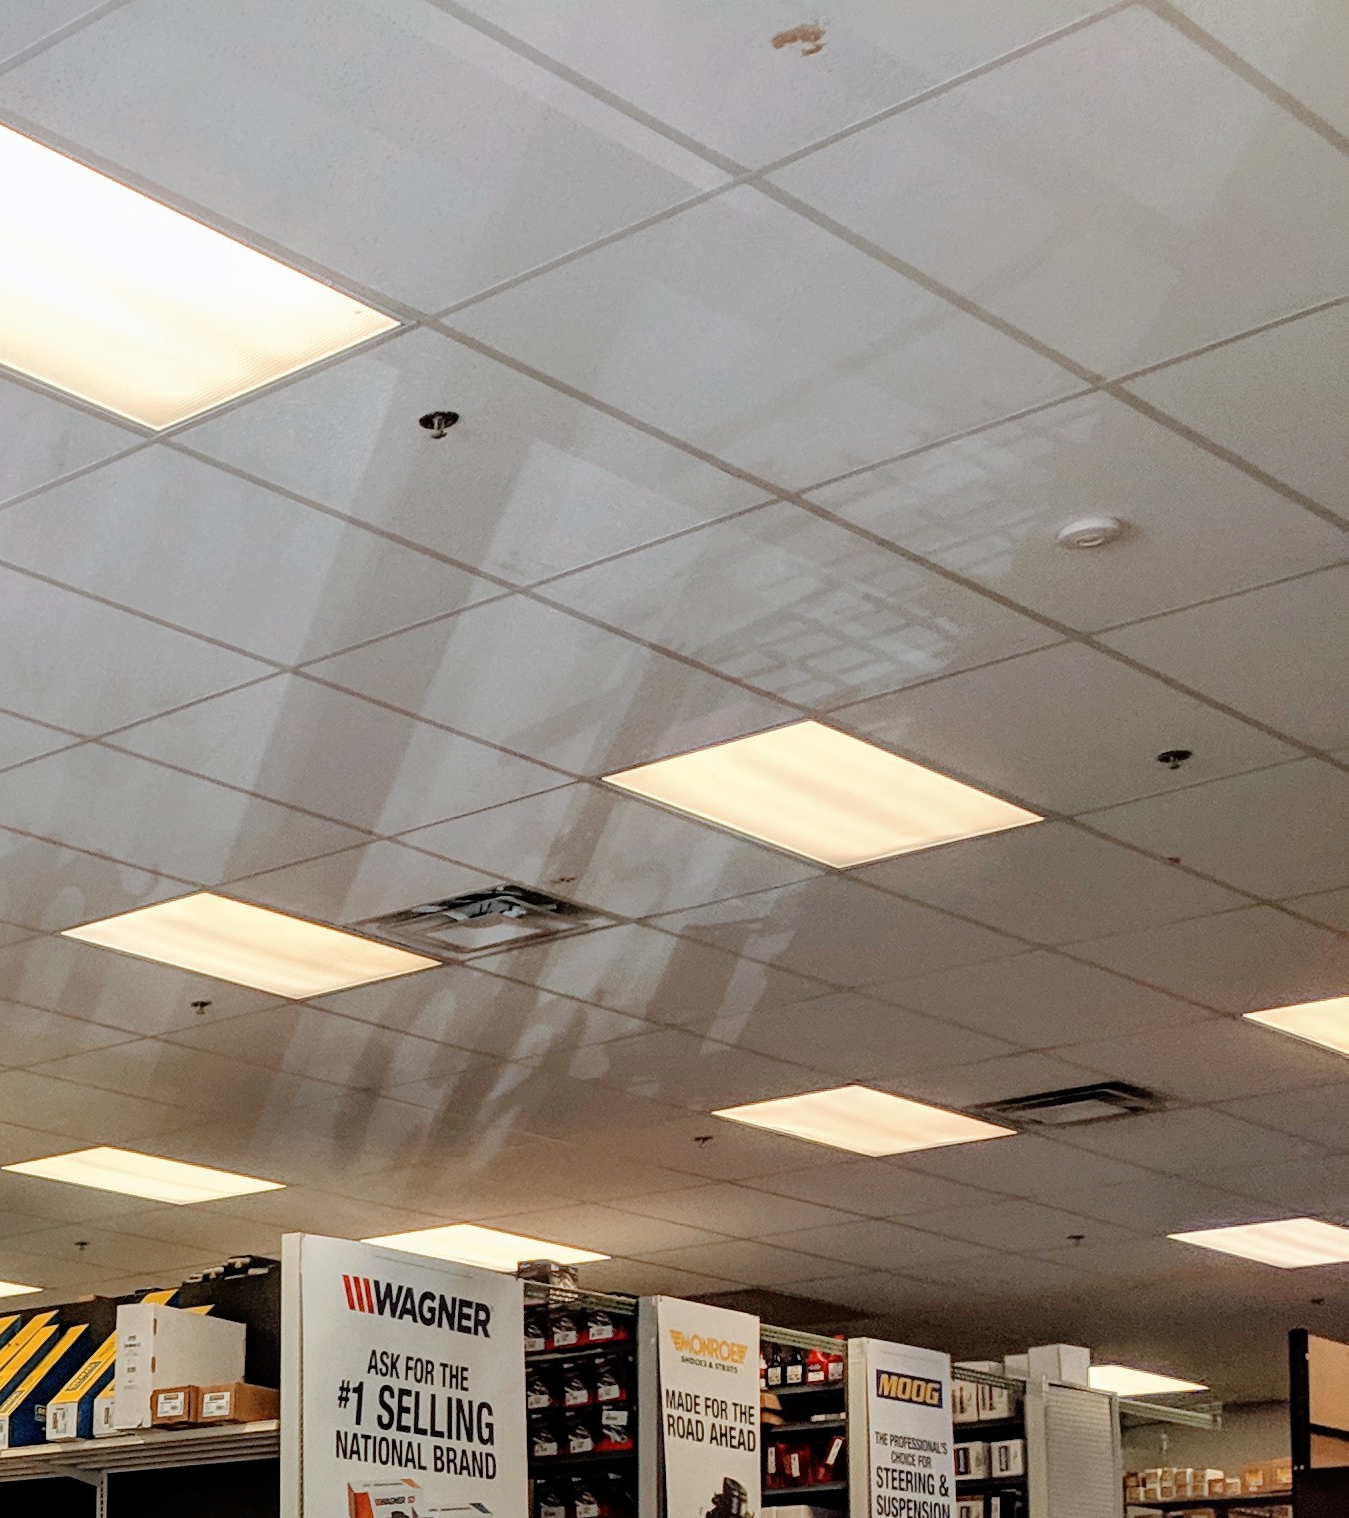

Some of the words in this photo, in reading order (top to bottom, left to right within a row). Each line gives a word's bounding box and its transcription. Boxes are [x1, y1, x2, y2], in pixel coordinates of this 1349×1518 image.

[374, 1280, 491, 1338] WAGNER
[671, 1330, 748, 1364] MONROE
[367, 1350, 400, 1379] ASK
[405, 1356, 434, 1385] FOR
[440, 1362, 469, 1392] THE
[878, 1373, 940, 1405] MOOG
[338, 1379, 364, 1426] #1
[377, 1384, 495, 1446] SELLING
[665, 1388, 701, 1415] MADE
[704, 1396, 728, 1420] FOR
[732, 1402, 755, 1425] THE
[667, 1414, 705, 1442] ROAD
[709, 1422, 756, 1452] AHEAD
[874, 1431, 889, 1447] THE
[335, 1430, 427, 1470] NATIONAL
[434, 1445, 497, 1480] BRAND
[891, 1451, 916, 1468] CHOICE
[918, 1455, 932, 1470] FOR
[876, 1465, 936, 1496] STEERING
[939, 1474, 950, 1498] &
